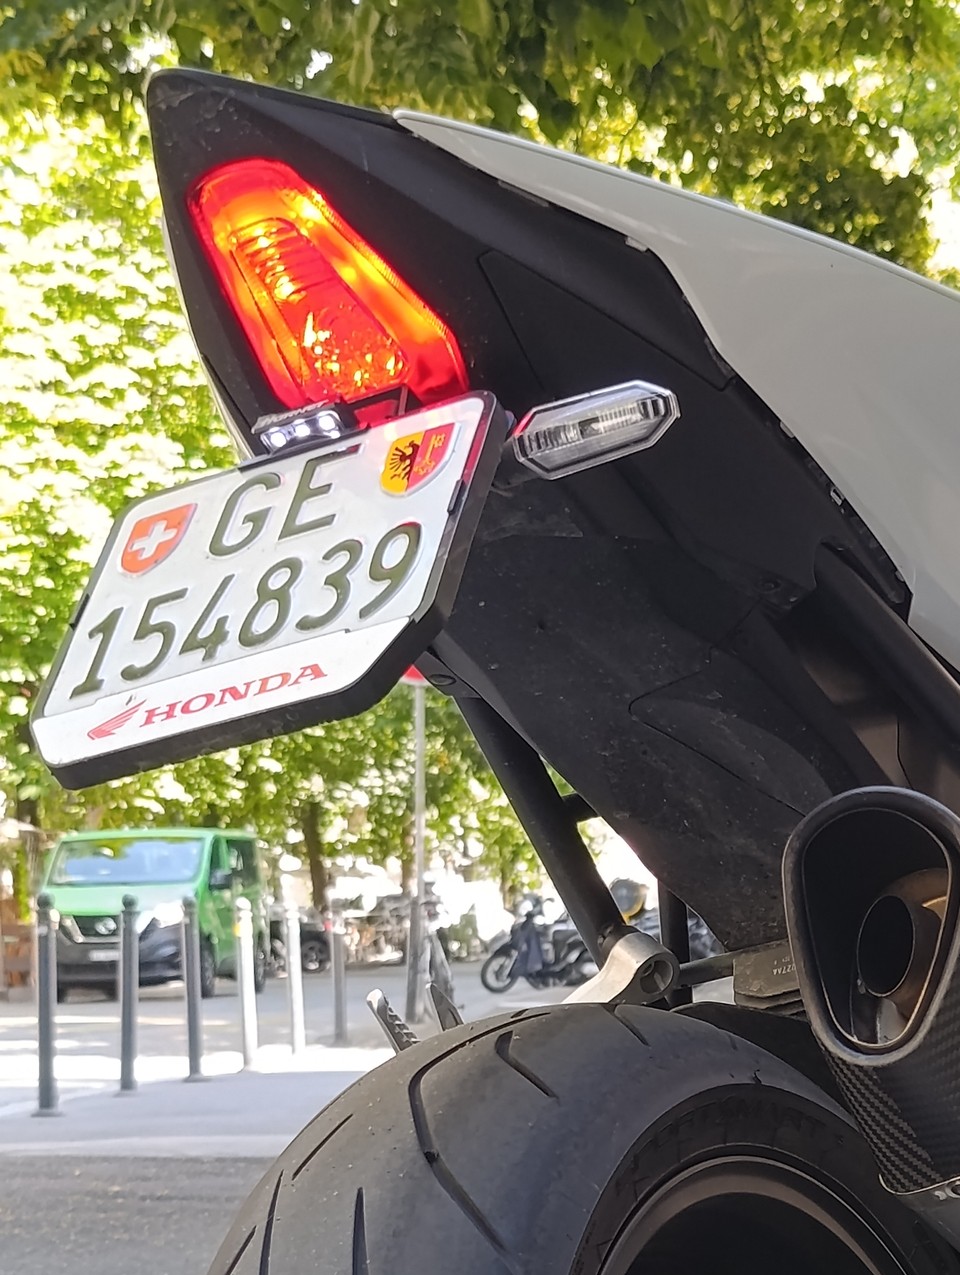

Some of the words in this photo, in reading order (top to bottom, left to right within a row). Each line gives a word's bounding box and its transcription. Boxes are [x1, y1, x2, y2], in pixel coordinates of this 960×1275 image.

[208, 442, 364, 557] GE
[69, 520, 423, 700] 154839
[139, 663, 327, 727] HONDA
